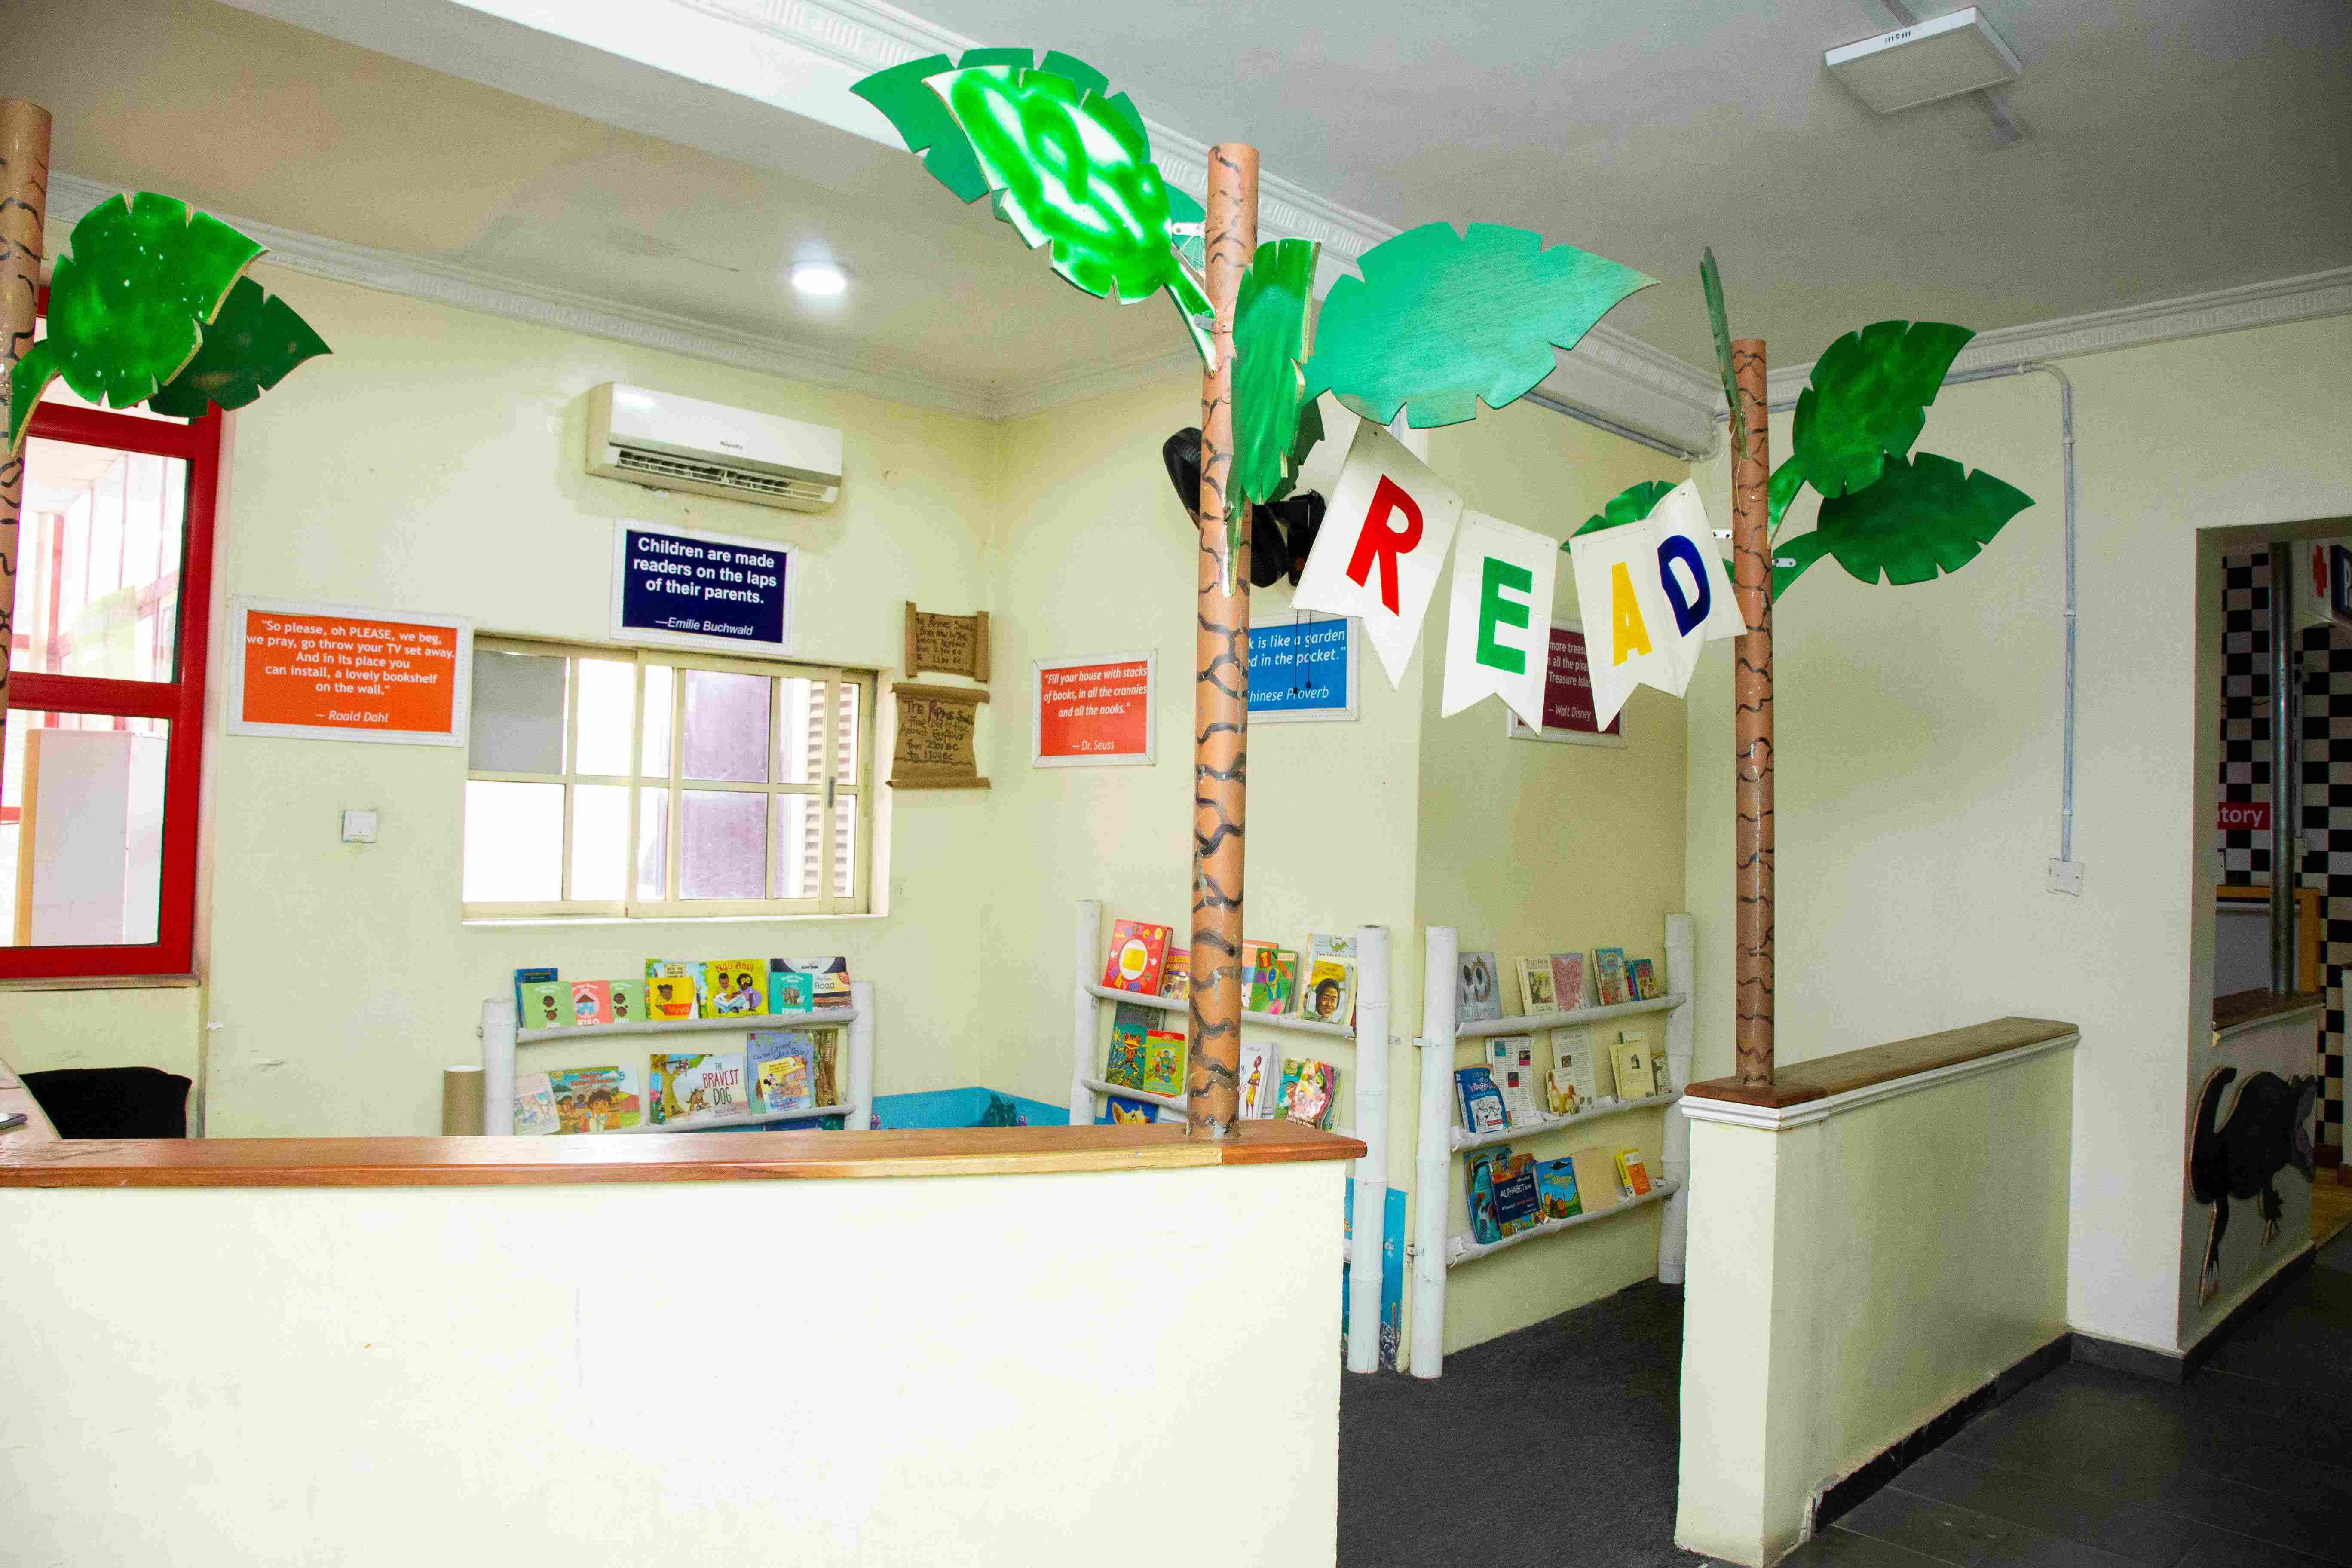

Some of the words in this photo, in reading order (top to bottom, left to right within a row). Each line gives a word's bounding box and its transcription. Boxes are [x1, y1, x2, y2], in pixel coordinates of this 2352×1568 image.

[638, 537, 704, 559] Children
[707, 550, 731, 562] are
[735, 553, 775, 568] made
[633, 558, 692, 576] readers
[696, 567, 715, 579] on
[719, 568, 743, 583] the
[747, 570, 777, 588] laps
[646, 578, 663, 591] of
[666, 579, 701, 596] their
[704, 586, 764, 604] parents.
[284, 622, 327, 636] please,
[331, 626, 346, 637] oh
[349, 627, 395, 642] PLEASE,
[399, 633, 415, 641] we
[703, 620, 753, 636] Buchwald
[246, 636, 263, 646] we
[268, 637, 297, 649] pray,
[301, 640, 315, 651] go
[318, 639, 354, 651] throw
[357, 644, 383, 655] your
[387, 643, 401, 654] TV
[404, 646, 421, 656] set
[424, 648, 455, 660] away.
[1258, 638, 1267, 649] is
[1270, 635, 1291, 648] like
[1294, 636, 1301, 646] a
[1305, 629, 1345, 648] garden
[1549, 641, 1567, 652] more
[296, 652, 319, 664] And
[323, 653, 334, 664] in
[338, 655, 352, 665] its
[355, 655, 386, 668] place
[389, 660, 410, 670] you
[1261, 653, 1271, 667] in
[1274, 652, 1293, 666] the
[1553, 656, 1561, 667] all
[1563, 658, 1574, 668] the
[1574, 660, 1589, 672] pira
[265, 665, 287, 675] can
[291, 664, 331, 679] install,
[345, 668, 380, 683] lovely
[383, 671, 438, 684] bookshelf
[1060, 674, 1078, 685] your
[1079, 671, 1102, 681] house
[1103, 668, 1121, 680] with
[1122, 666, 1147, 678] stacks
[1548, 671, 1577, 686] Treasure
[315, 683, 331, 692] on
[334, 682, 354, 693] the
[1044, 690, 1053, 704] of
[1053, 689, 1077, 701] books,
[1078, 689, 1086, 699] in
[1087, 686, 1097, 698] all
[1099, 686, 1112, 697] the
[1248, 690, 1284, 704] hinese
[328, 710, 361, 722] Roald
[364, 711, 389, 723] Dahl
[1058, 706, 1074, 718] and
[1074, 704, 1084, 716] all
[1086, 705, 1098, 716] the
[1555, 704, 1571, 717] Walt
[1571, 706, 1592, 722] Disney
[1081, 740, 1091, 751] Dr.
[1093, 740, 1115, 750] Seuss
[2217, 806, 2263, 827] tory
[702, 1069, 739, 1089] BRAVEST
[713, 1087, 732, 1106] DOG
